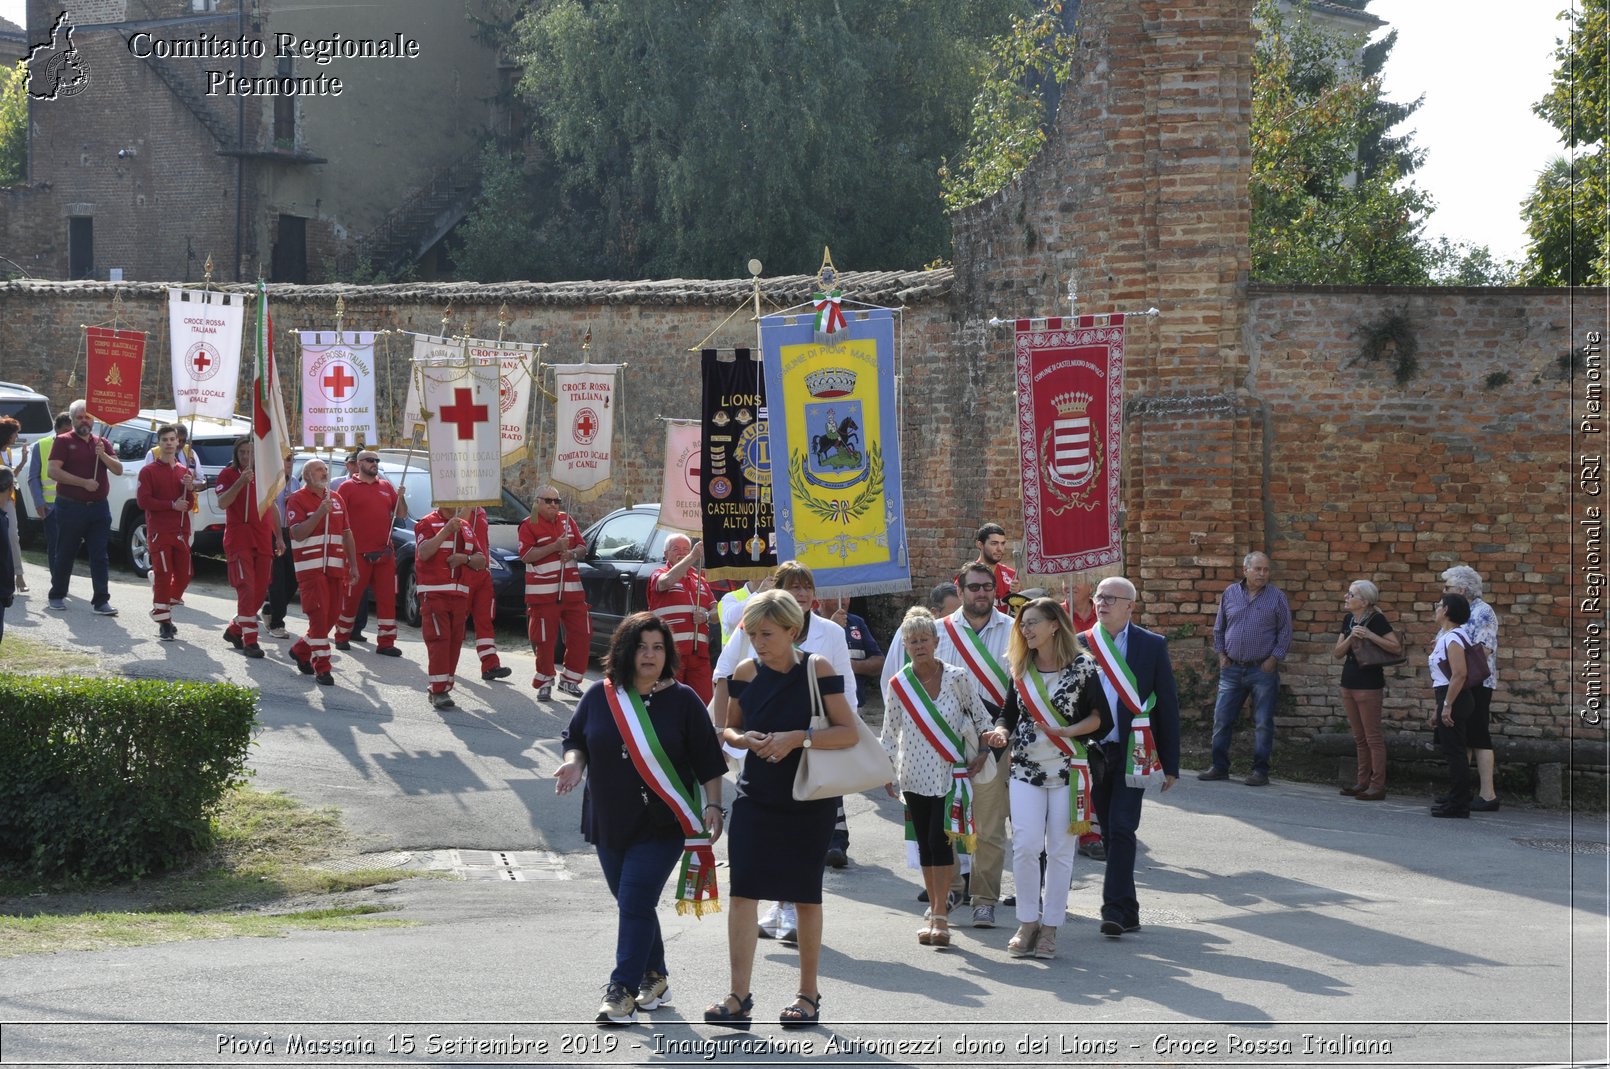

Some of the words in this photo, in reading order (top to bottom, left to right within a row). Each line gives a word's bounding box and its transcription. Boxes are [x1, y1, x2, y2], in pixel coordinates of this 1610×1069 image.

[471, 348, 498, 357] CROCE
[808, 349, 817, 358] DI
[309, 355, 327, 377] CROCE
[326, 350, 346, 360] ROSSA
[347, 352, 370, 377] ITALIANA
[480, 359, 518, 369] ITANA
[562, 382, 587, 392] CROCE
[590, 382, 610, 391] ROSSA
[202, 389, 225, 398] LOCALE
[570, 393, 603, 402] ITALIANA
[721, 394, 762, 407] LIONS
[407, 412, 424, 422] VILLA
[502, 432, 522, 441] RATO
[431, 452, 468, 462] COMITATO
[472, 450, 500, 461] LOCALE
[558, 451, 588, 461] COMITATO
[676, 447, 690, 468] CROCE
[439, 470, 456, 479] SAN
[461, 469, 494, 479] DAMIANO
[708, 503, 766, 515] CASTELNUOVO
[723, 517, 748, 528] ALTO
